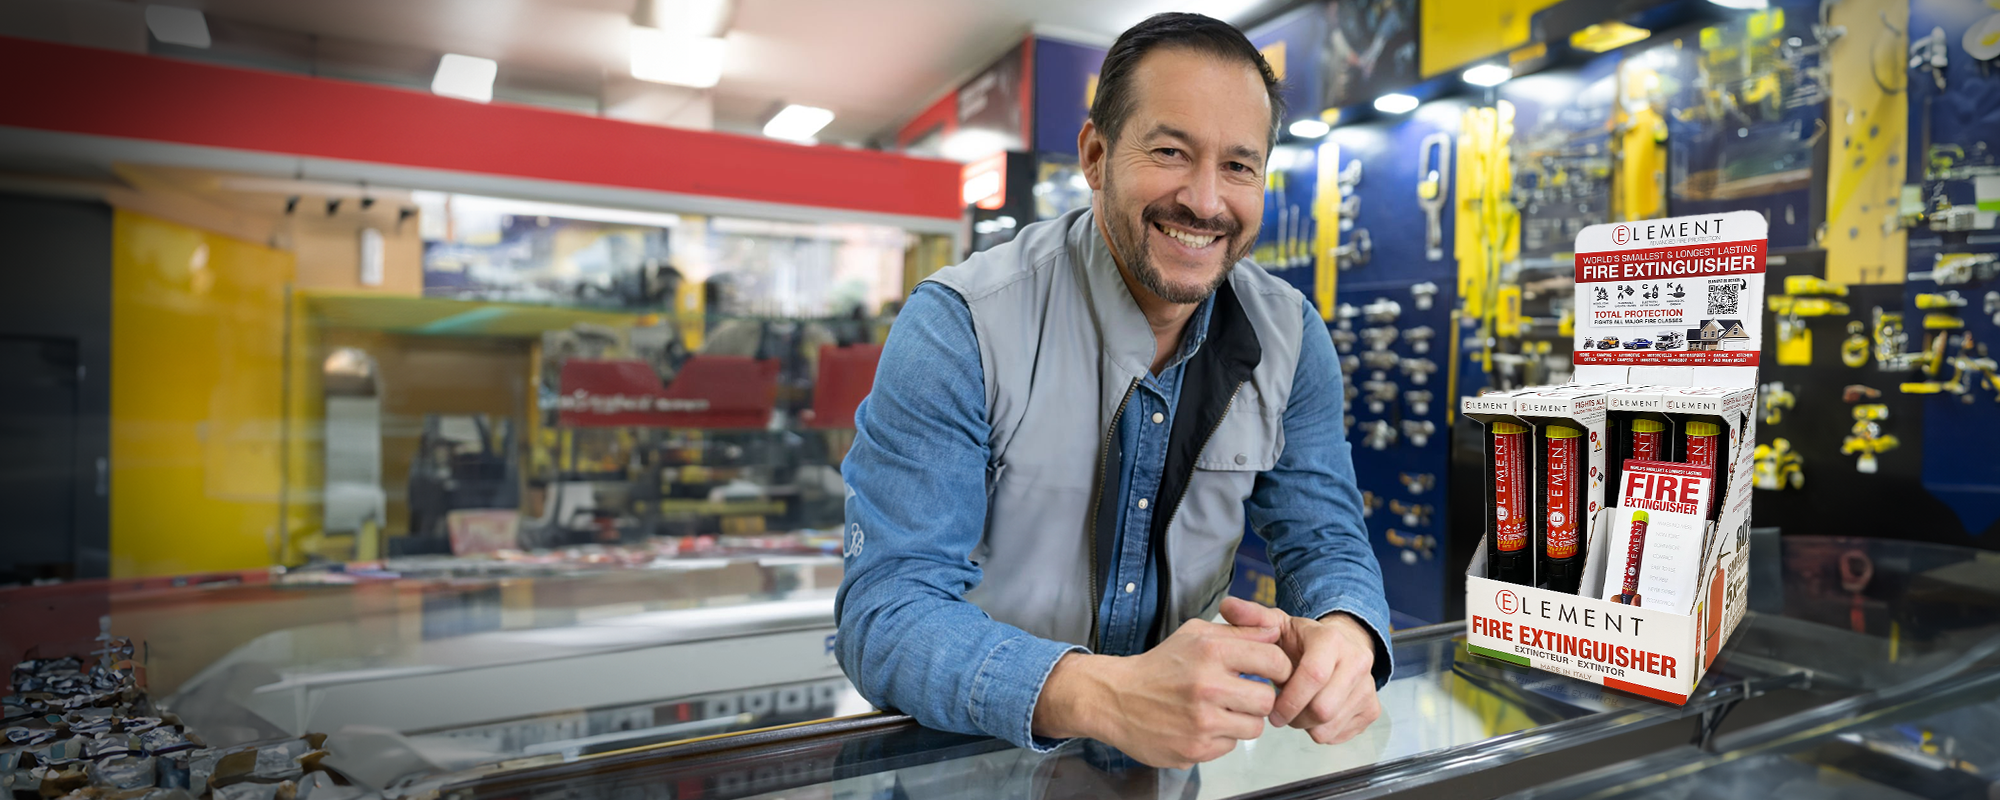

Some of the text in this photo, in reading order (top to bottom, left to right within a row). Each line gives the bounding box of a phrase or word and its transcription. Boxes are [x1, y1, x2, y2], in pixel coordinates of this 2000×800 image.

[1612, 219, 1724, 246] ELEMENT
[1583, 244, 1758, 264] WORLD'S SMALLEST & LONGEST LASTING
[1583, 255, 1756, 280] FIRE EXTINGUISHER
[1594, 308, 1683, 319] TOTAL PROTECTION
[1464, 401, 1508, 410] ELEMENT
[1520, 402, 1567, 412] ELEMENT
[1575, 399, 1595, 409] FIGHTS
[1610, 397, 1659, 408] ELEMENT
[1665, 400, 1718, 411] ELEMENT
[1495, 433, 1510, 522] ELEMENT
[1549, 437, 1566, 528] ELEMENT
[1625, 472, 1701, 505] FIRE
[1624, 496, 1698, 516] EXTINGUISHER
[1628, 521, 1644, 576] ELEMENT
[1495, 589, 1644, 637] ELEMENT
[1472, 614, 1514, 642] FIRE
[1519, 624, 1678, 680] EXTINGUISHER
[1514, 644, 1570, 666] EXTINCTEUR
[1577, 659, 1626, 678] EXTINTOR
[1562, 667, 1571, 676] IN
[1572, 669, 1593, 682] ITALY
